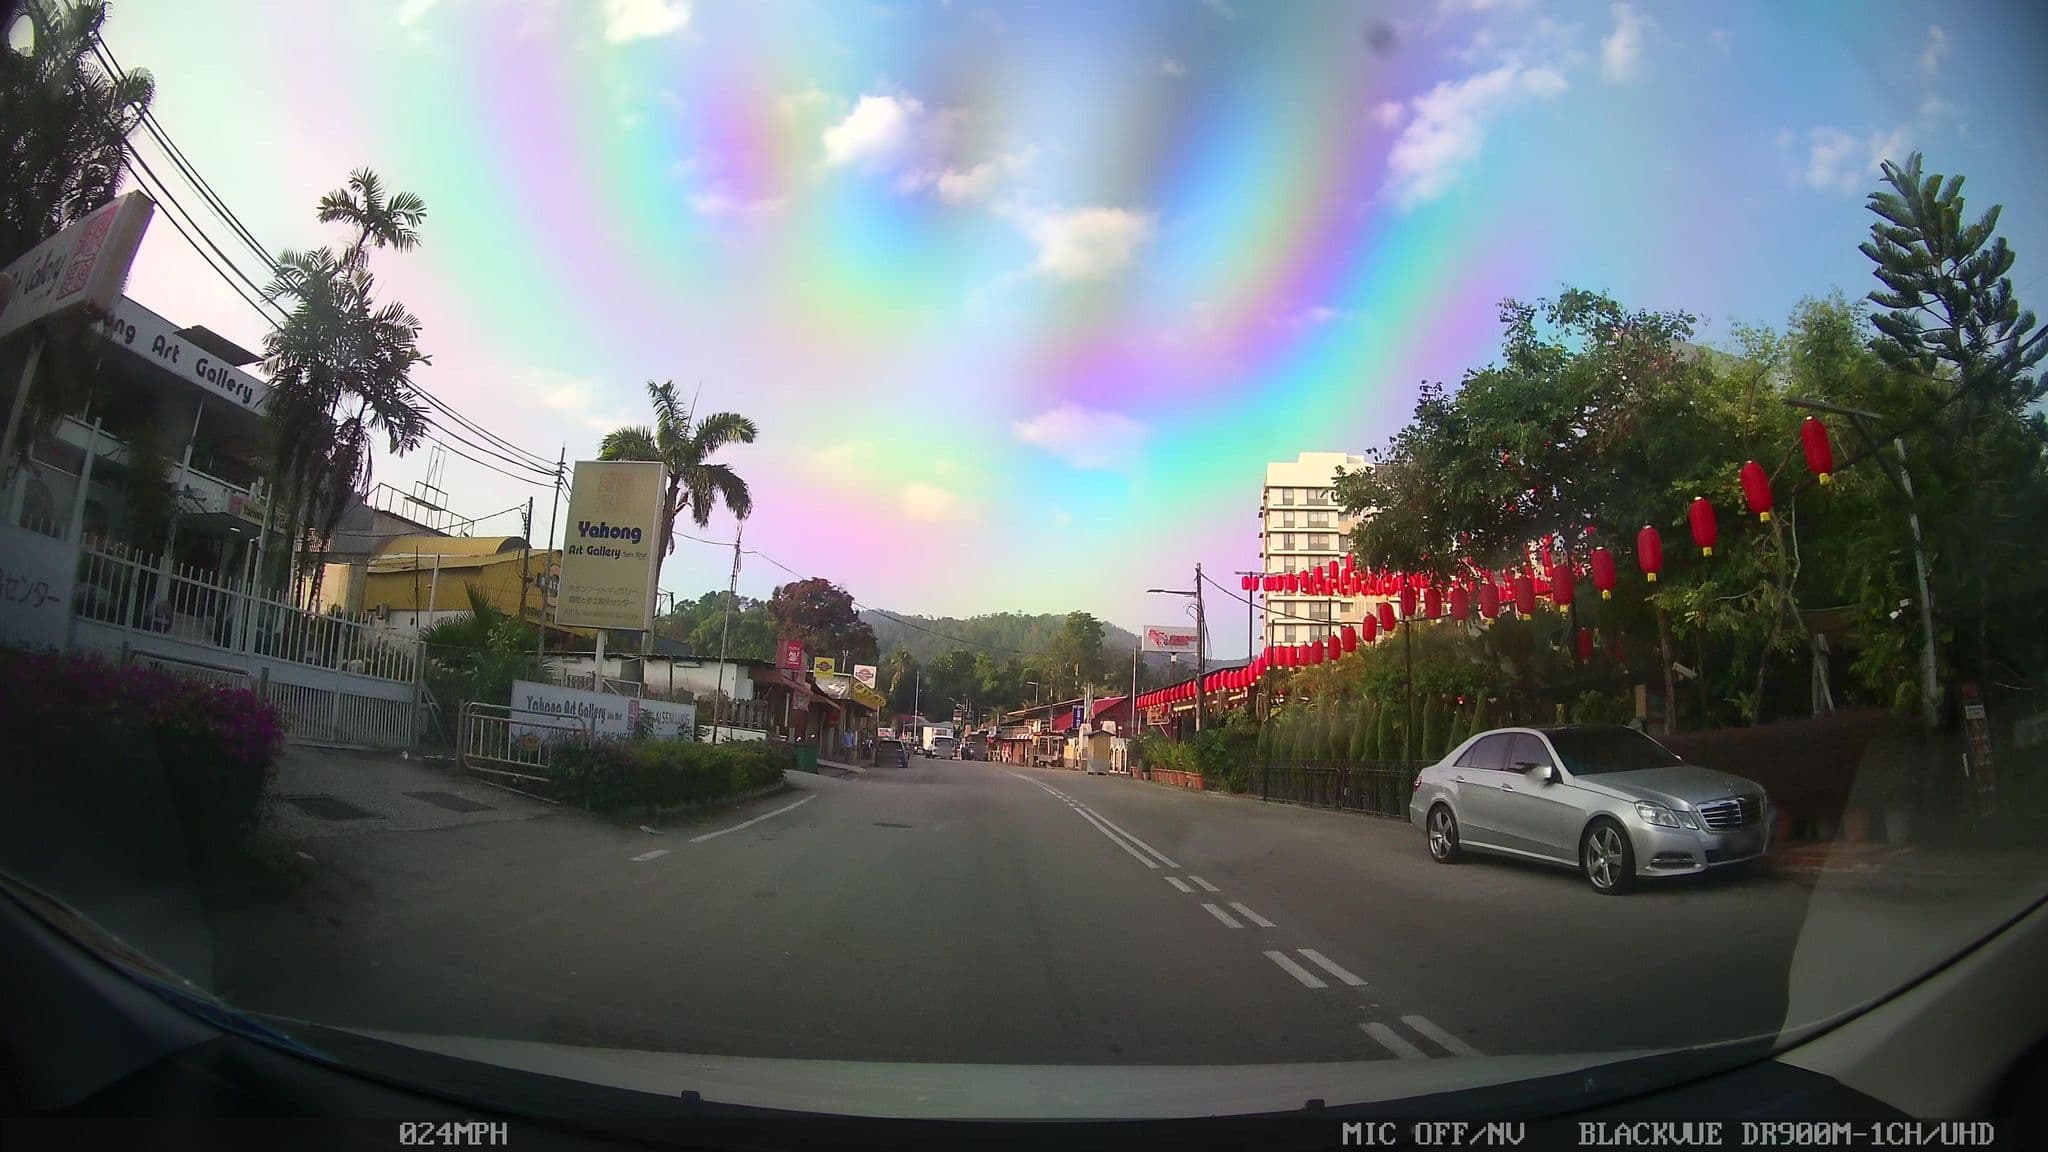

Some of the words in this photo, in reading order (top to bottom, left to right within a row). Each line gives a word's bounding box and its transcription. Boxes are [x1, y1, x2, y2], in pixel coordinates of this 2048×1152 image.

[152, 334, 181, 364] Art
[195, 357, 254, 405] Gallery
[578, 520, 642, 545] Yahong
[568, 544, 584, 556] Art
[586, 545, 621, 560] Gallery
[563, 700, 577, 714] Art
[578, 702, 606, 723] Gallery
